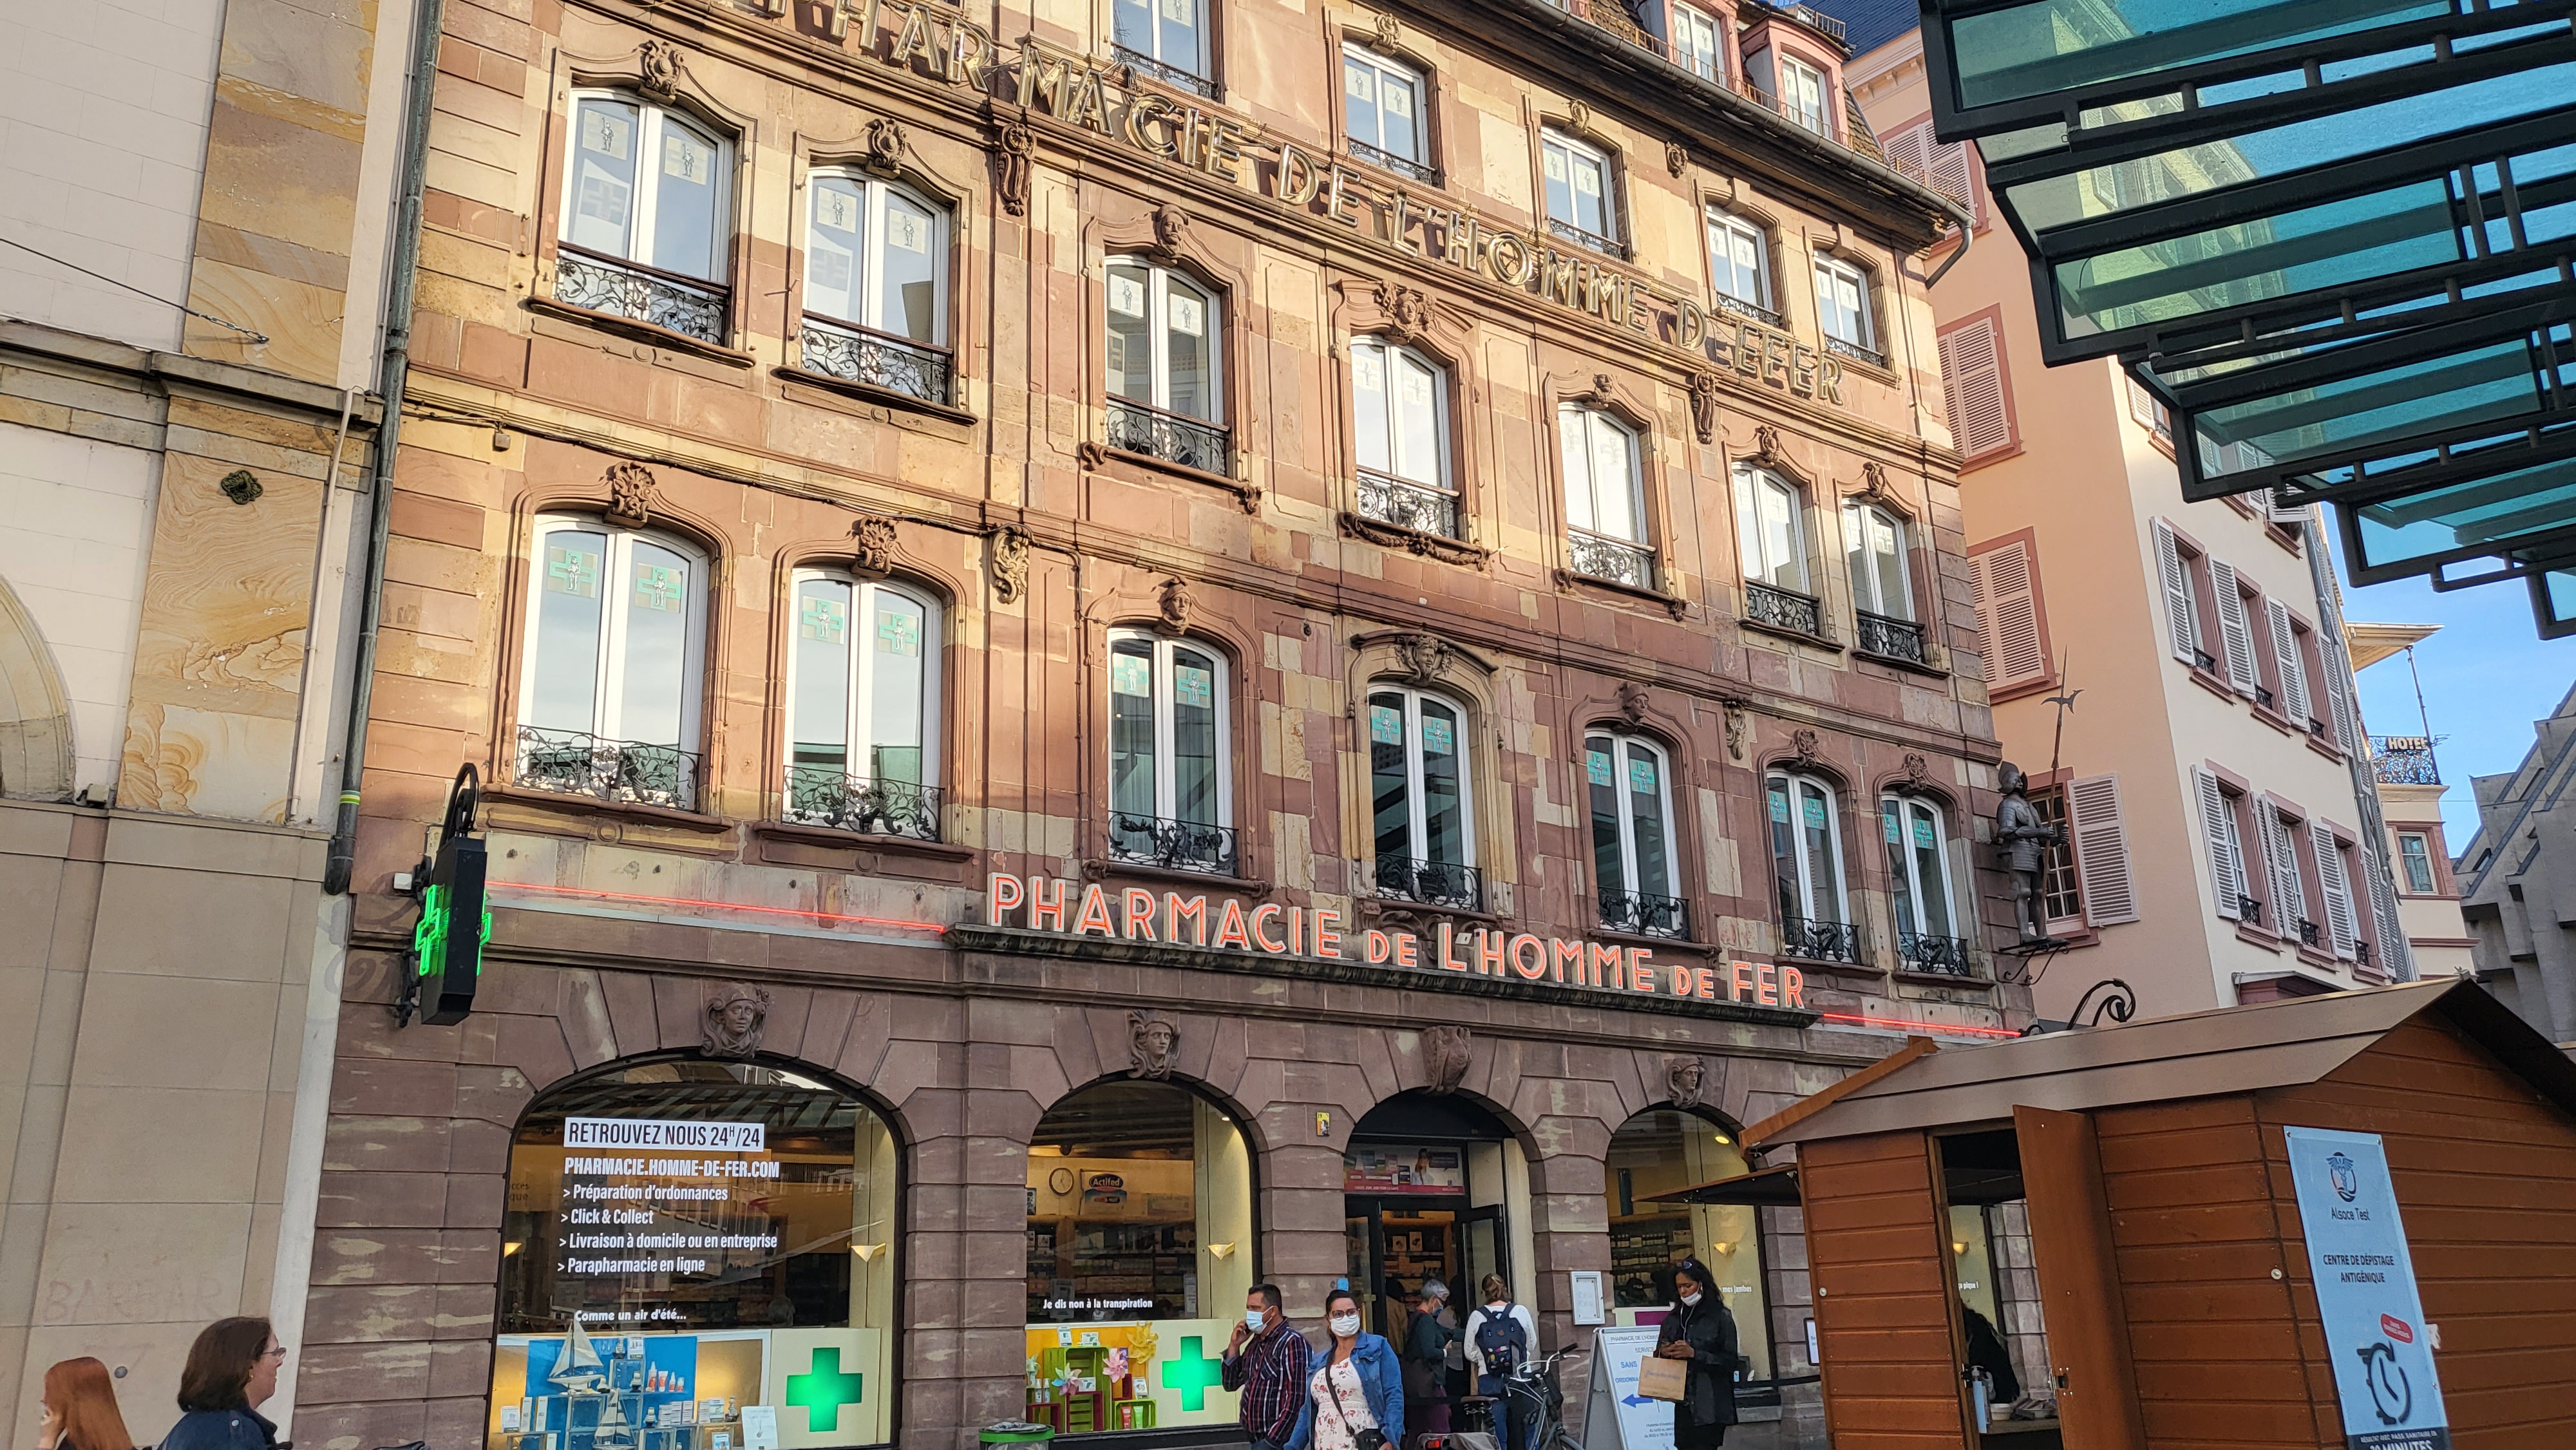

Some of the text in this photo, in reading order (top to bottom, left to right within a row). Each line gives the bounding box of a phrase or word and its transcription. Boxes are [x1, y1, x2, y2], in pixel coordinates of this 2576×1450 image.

[769, 0, 1243, 182] HARMACIE
[1277, 143, 1362, 226] DE
[1390, 184, 1651, 335] L'HOMME
[987, 872, 1806, 1009] PHARMACIE DE L'HOMME DE FER
[568, 1122, 661, 1145] RETROUVEZ
[665, 1124, 707, 1146] NOUS
[564, 1157, 780, 1178] PHARMACIE.HOMME-DE-FER.COM
[1092, 1177, 1121, 1187] Actifed
[573, 1183, 642, 1202] Préparation
[645, 1184, 728, 1201] d'ordonnances
[571, 1209, 600, 1225] Click
[601, 1210, 611, 1225] &
[613, 1209, 654, 1225] Collect
[2331, 1207, 2371, 1221] Alsace Test
[569, 1232, 624, 1248] Livraison
[626, 1232, 634, 1248] à
[636, 1232, 686, 1248] domicile
[688, 1236, 702, 1248] ou
[704, 1236, 718, 1248] en
[720, 1234, 777, 1251] entreprise
[567, 1257, 658, 1276] Parapharmacie
[659, 1260, 674, 1272] en
[676, 1256, 705, 1276] ligne
[2323, 1252, 2395, 1266] CENTRE DE DÉPISTAGE
[2340, 1270, 2386, 1284] ANTIGÉNIQUE
[1043, 1298, 1153, 1310] Je dis non à la transpiration
[574, 1310, 615, 1322] Comme
[618, 1311, 632, 1321] un
[634, 1309, 649, 1321] air
